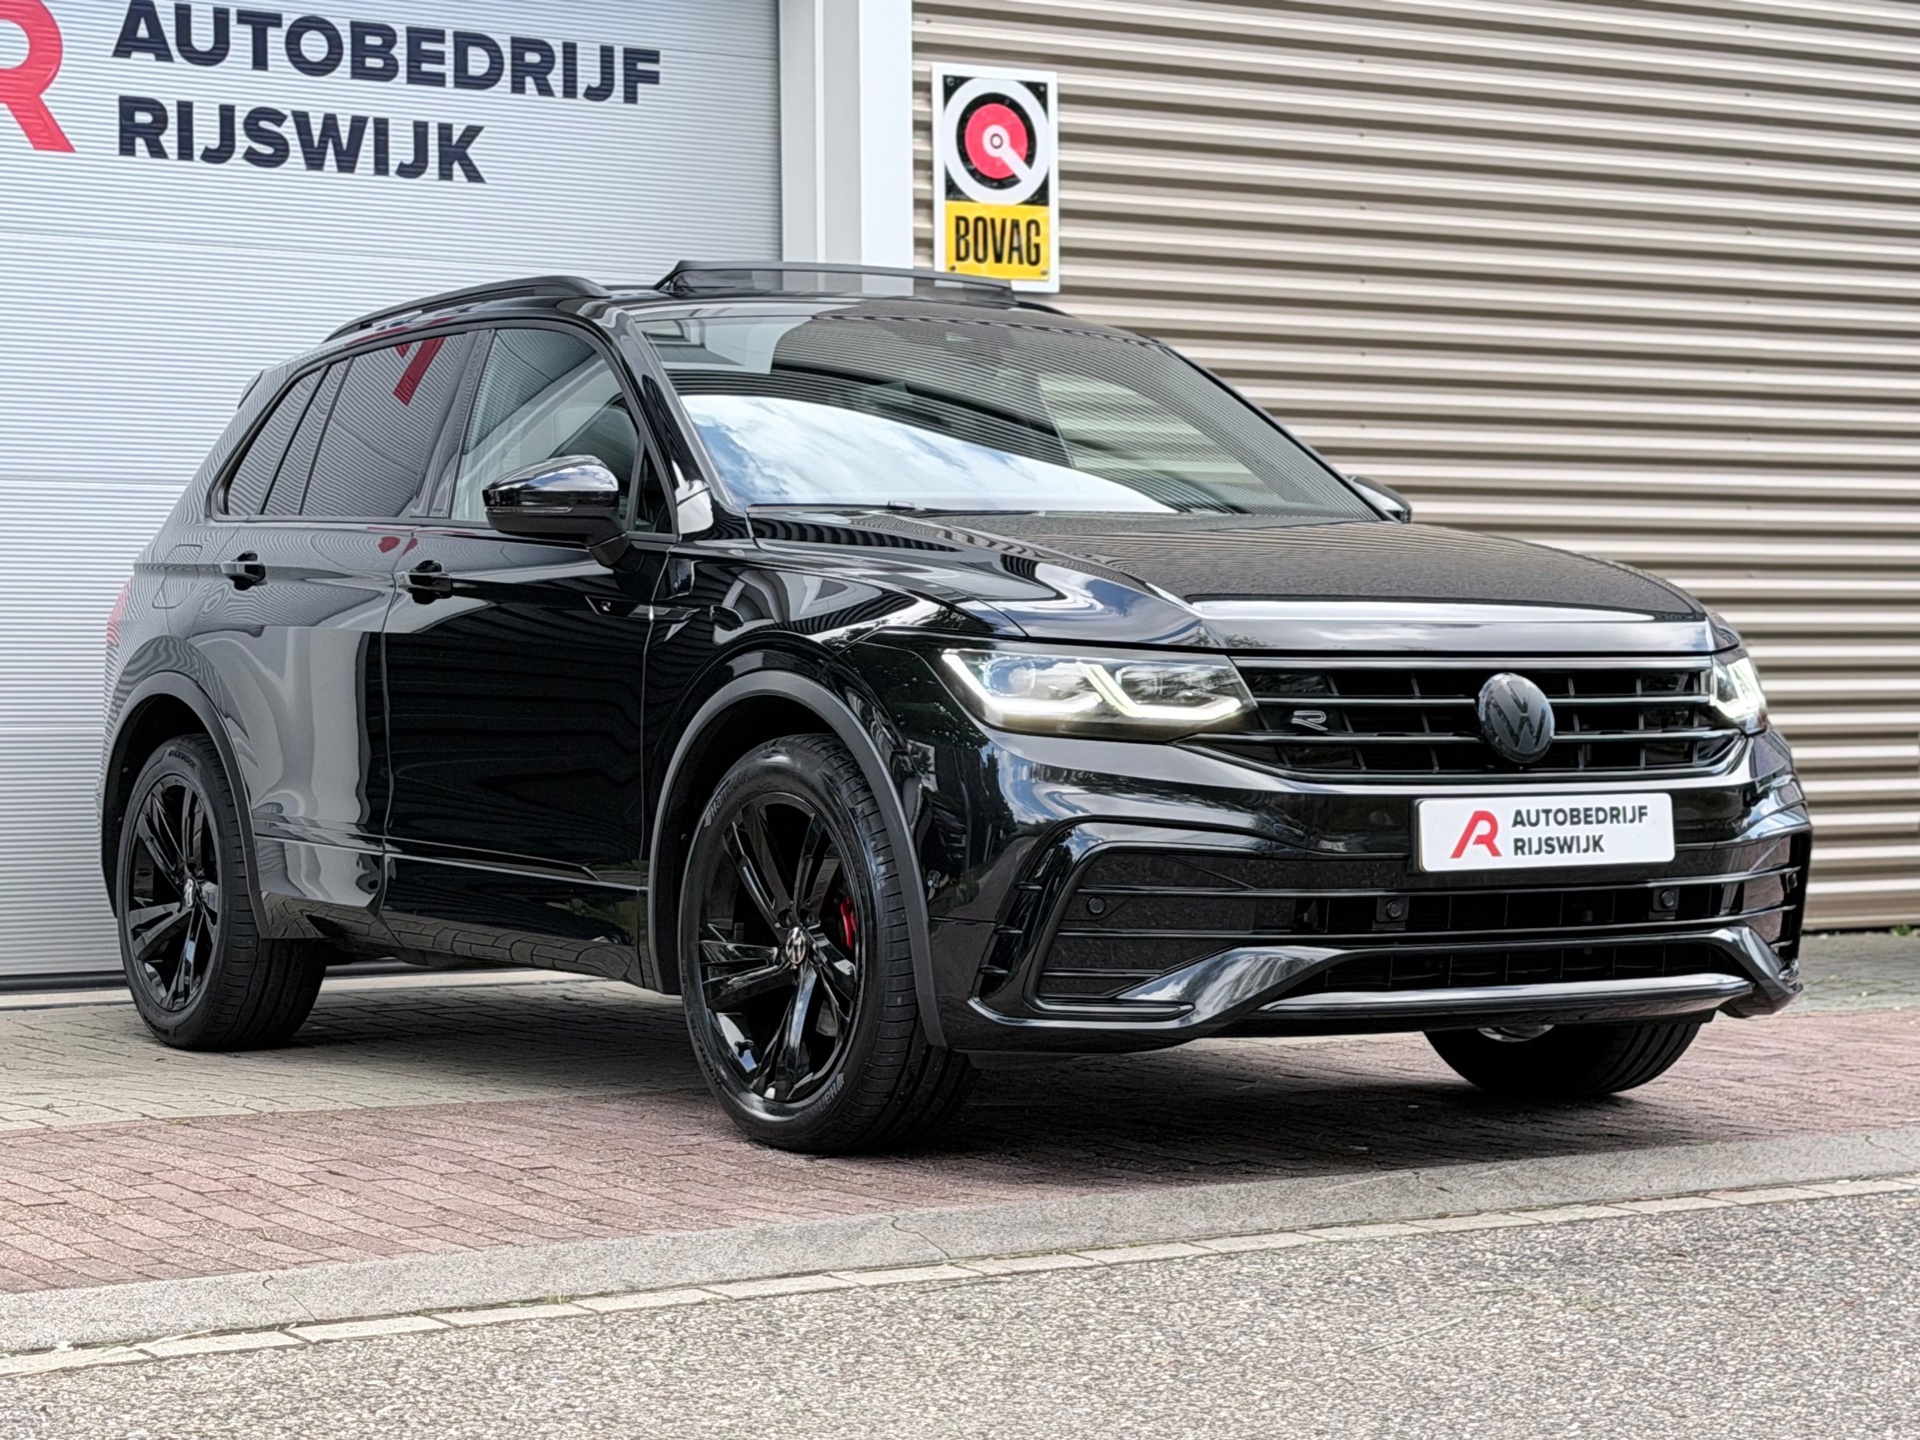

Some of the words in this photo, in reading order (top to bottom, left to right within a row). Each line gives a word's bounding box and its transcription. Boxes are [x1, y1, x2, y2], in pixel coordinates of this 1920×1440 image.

[112, 0, 661, 104] AUTOBEDRIJF
[118, 95, 487, 183] RIJSWIJK
[955, 215, 1041, 266] BOVAG
[1291, 710, 1329, 731] R
[1512, 805, 1649, 828] AUTOBEDRIJF
[1513, 834, 1605, 856] RIJSWIJK
